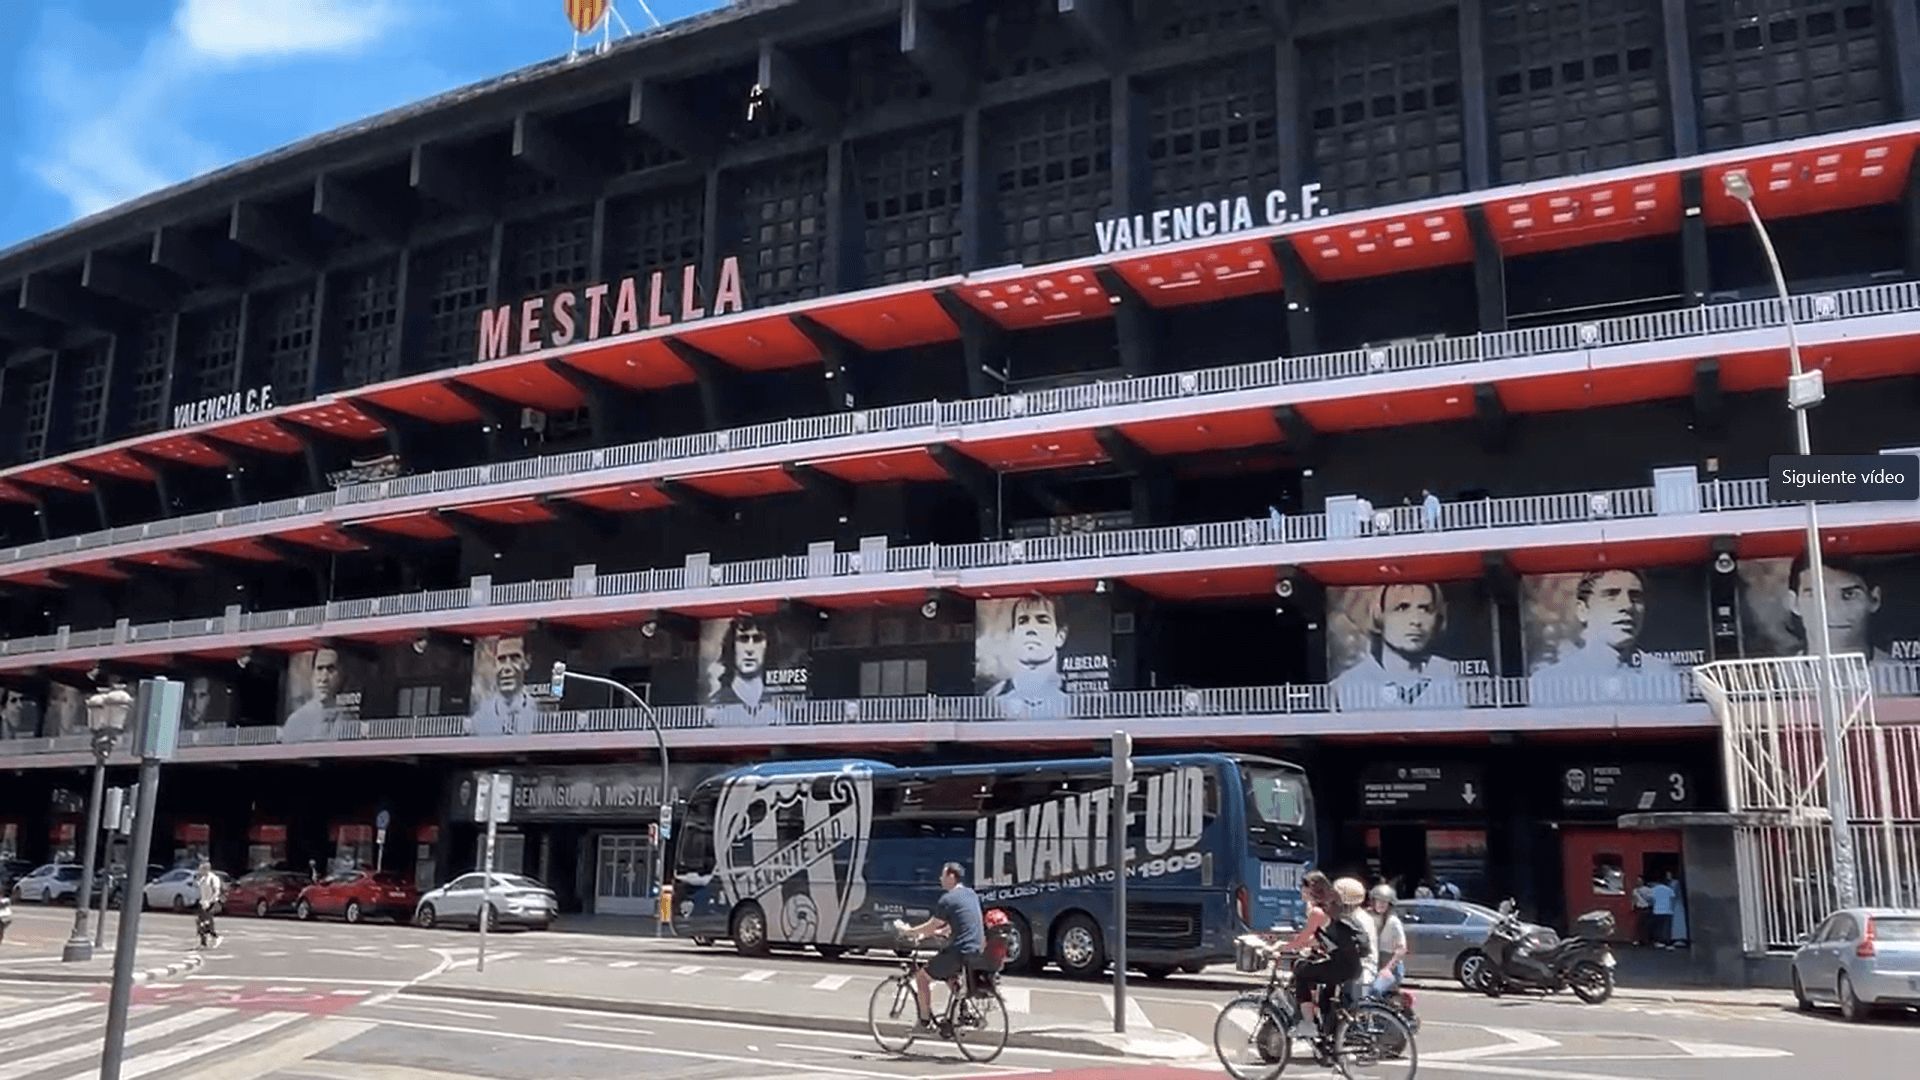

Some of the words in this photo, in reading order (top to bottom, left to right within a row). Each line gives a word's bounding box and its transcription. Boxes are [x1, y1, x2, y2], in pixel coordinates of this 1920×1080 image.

[1095, 196, 1253, 253] VALENCIA
[1266, 183, 1329, 225] C.F.
[477, 256, 743, 361] MESTALLA
[174, 392, 241, 428] VALENCIA
[246, 385, 272, 413] C.F.
[765, 668, 808, 685] KEMPES
[592, 786, 602, 807] A
[1669, 773, 1685, 801] 3
[974, 780, 1139, 890] LEVANTE
[1146, 767, 1204, 856] UD
[745, 838, 811, 896] LEVANTE
[999, 883, 1045, 900] OLDEST
[1098, 867, 1136, 882] TON
[1138, 852, 1202, 879] 1909
